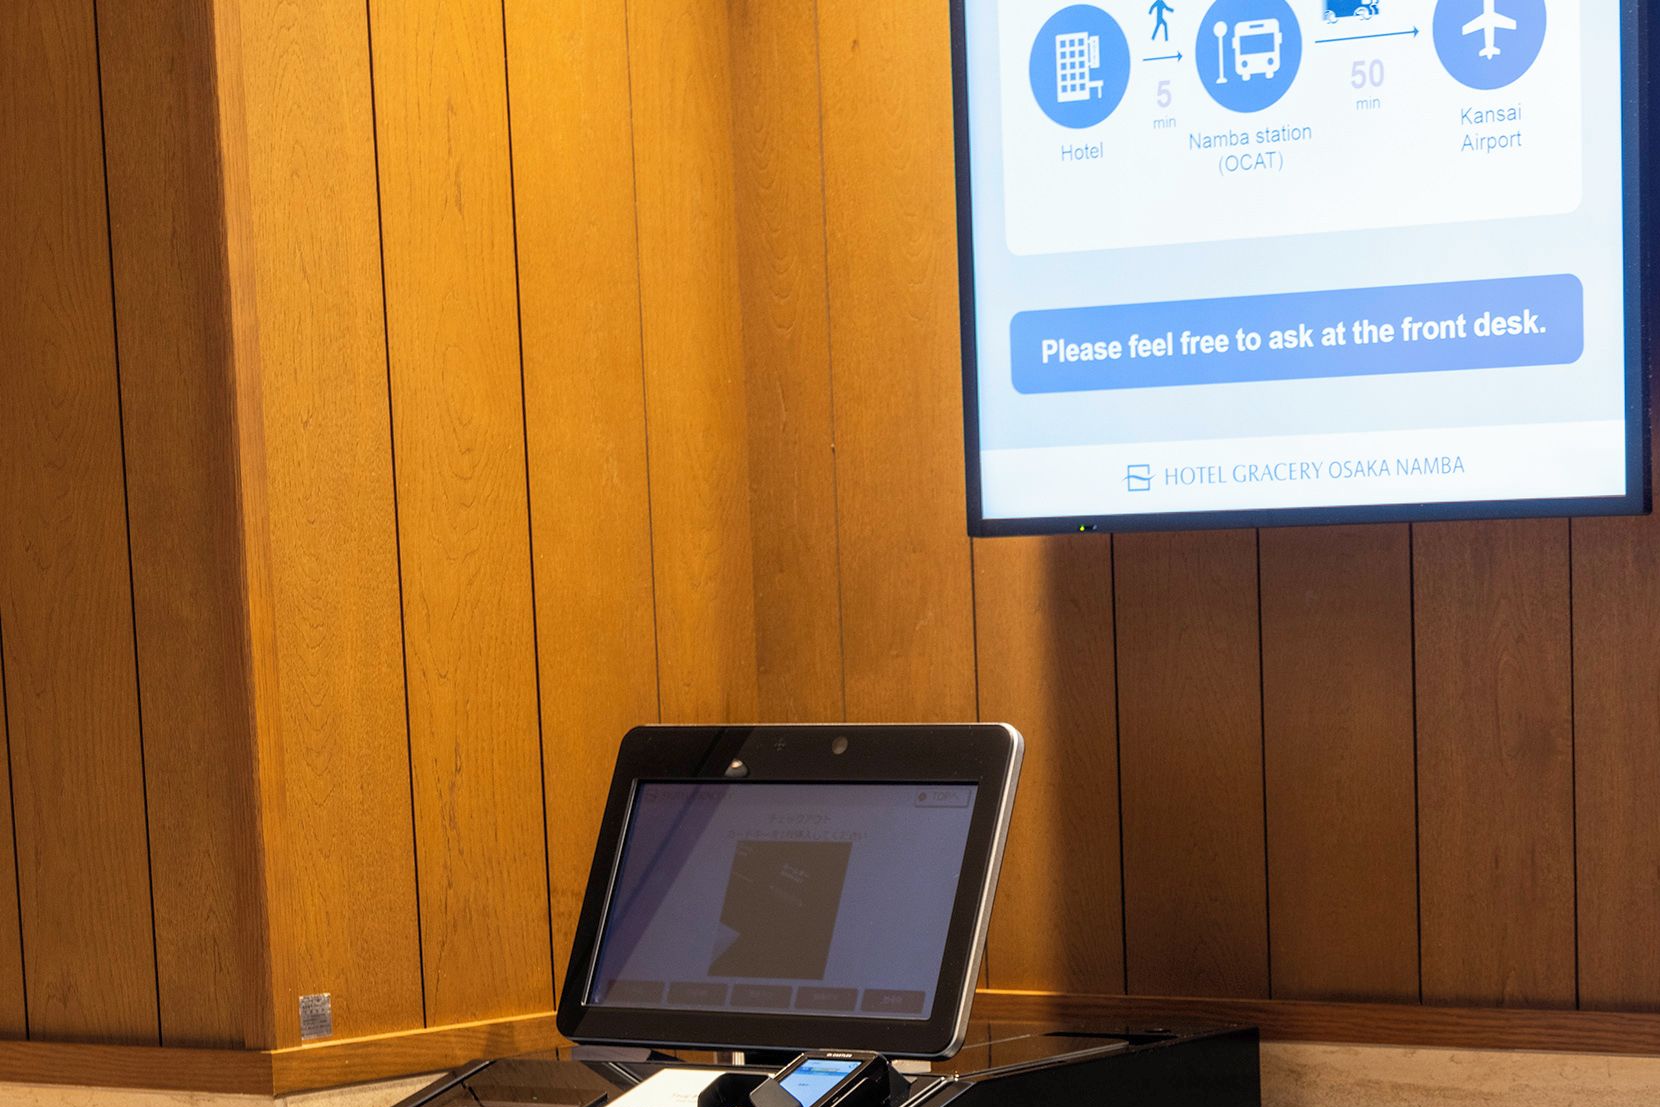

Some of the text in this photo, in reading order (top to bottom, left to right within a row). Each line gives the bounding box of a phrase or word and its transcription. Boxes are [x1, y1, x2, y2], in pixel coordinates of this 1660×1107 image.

[1350, 58, 1385, 89] 50
[1156, 80, 1172, 108] 5
[1355, 96, 1381, 111] min
[1153, 116, 1177, 130] min
[1460, 103, 1522, 125] Kansai
[1189, 124, 1312, 151] Namba station
[1460, 130, 1522, 154] Airport
[1061, 141, 1104, 162] Hotel
[1218, 151, 1284, 177] (OCAT)
[1042, 309, 1547, 364] Please feel free to ask at the front desk.
[1164, 455, 1465, 486] HOTEL GRACERY OSAKA NAMBA
